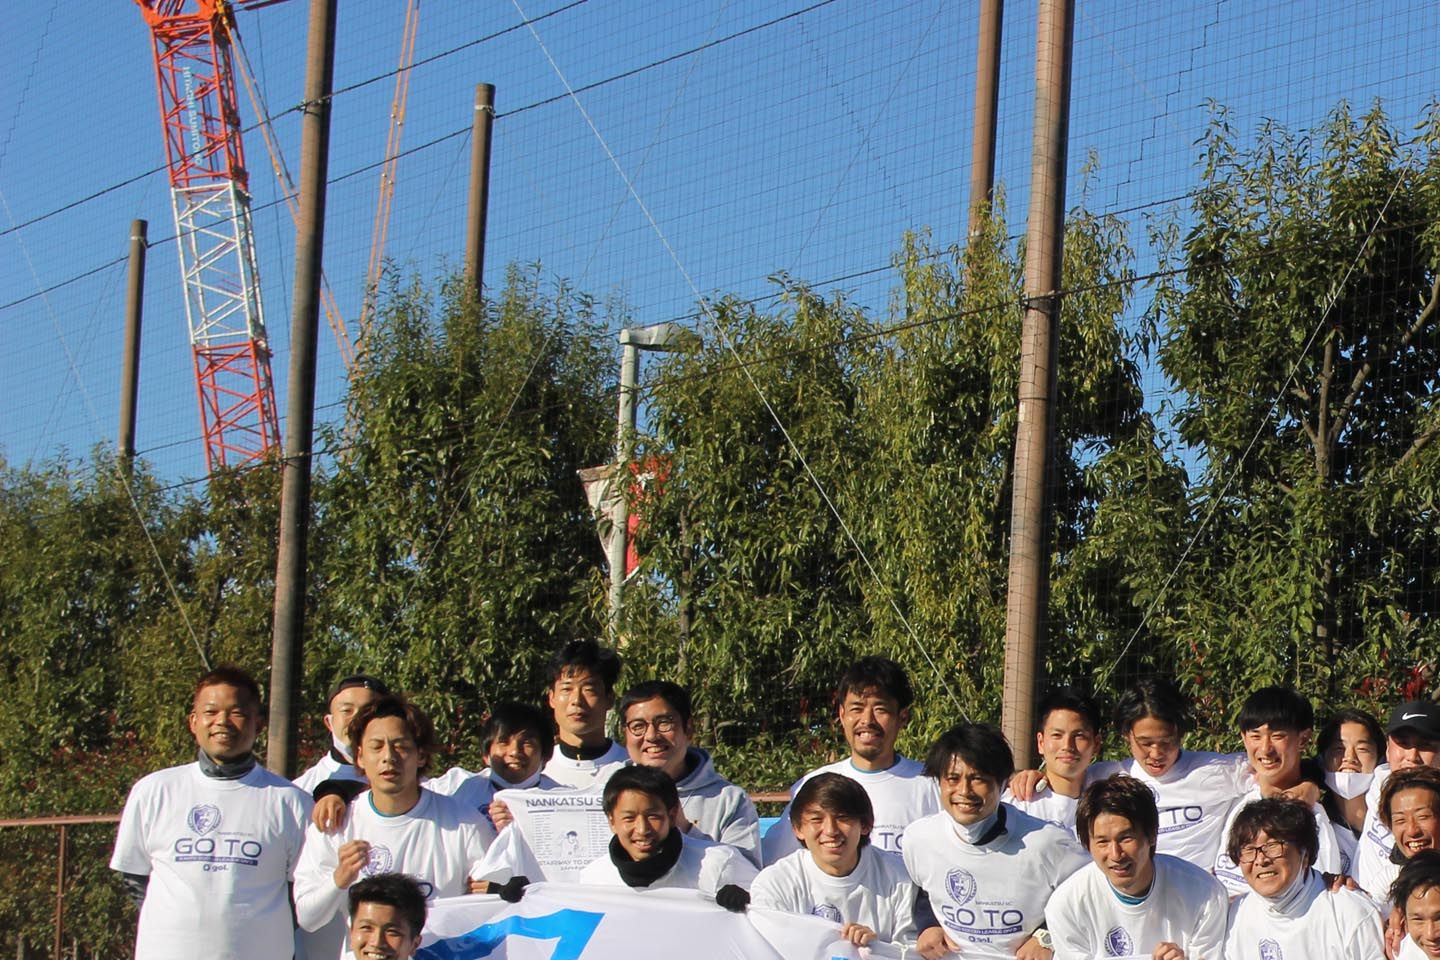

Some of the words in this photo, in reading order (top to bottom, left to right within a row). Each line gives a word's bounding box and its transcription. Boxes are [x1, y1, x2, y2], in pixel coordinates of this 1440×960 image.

[526, 796, 594, 807] NANKATSU
[174, 838, 215, 854] GO
[224, 839, 262, 858] TO
[942, 905, 975, 926] GO
[983, 909, 1023, 927] TO
